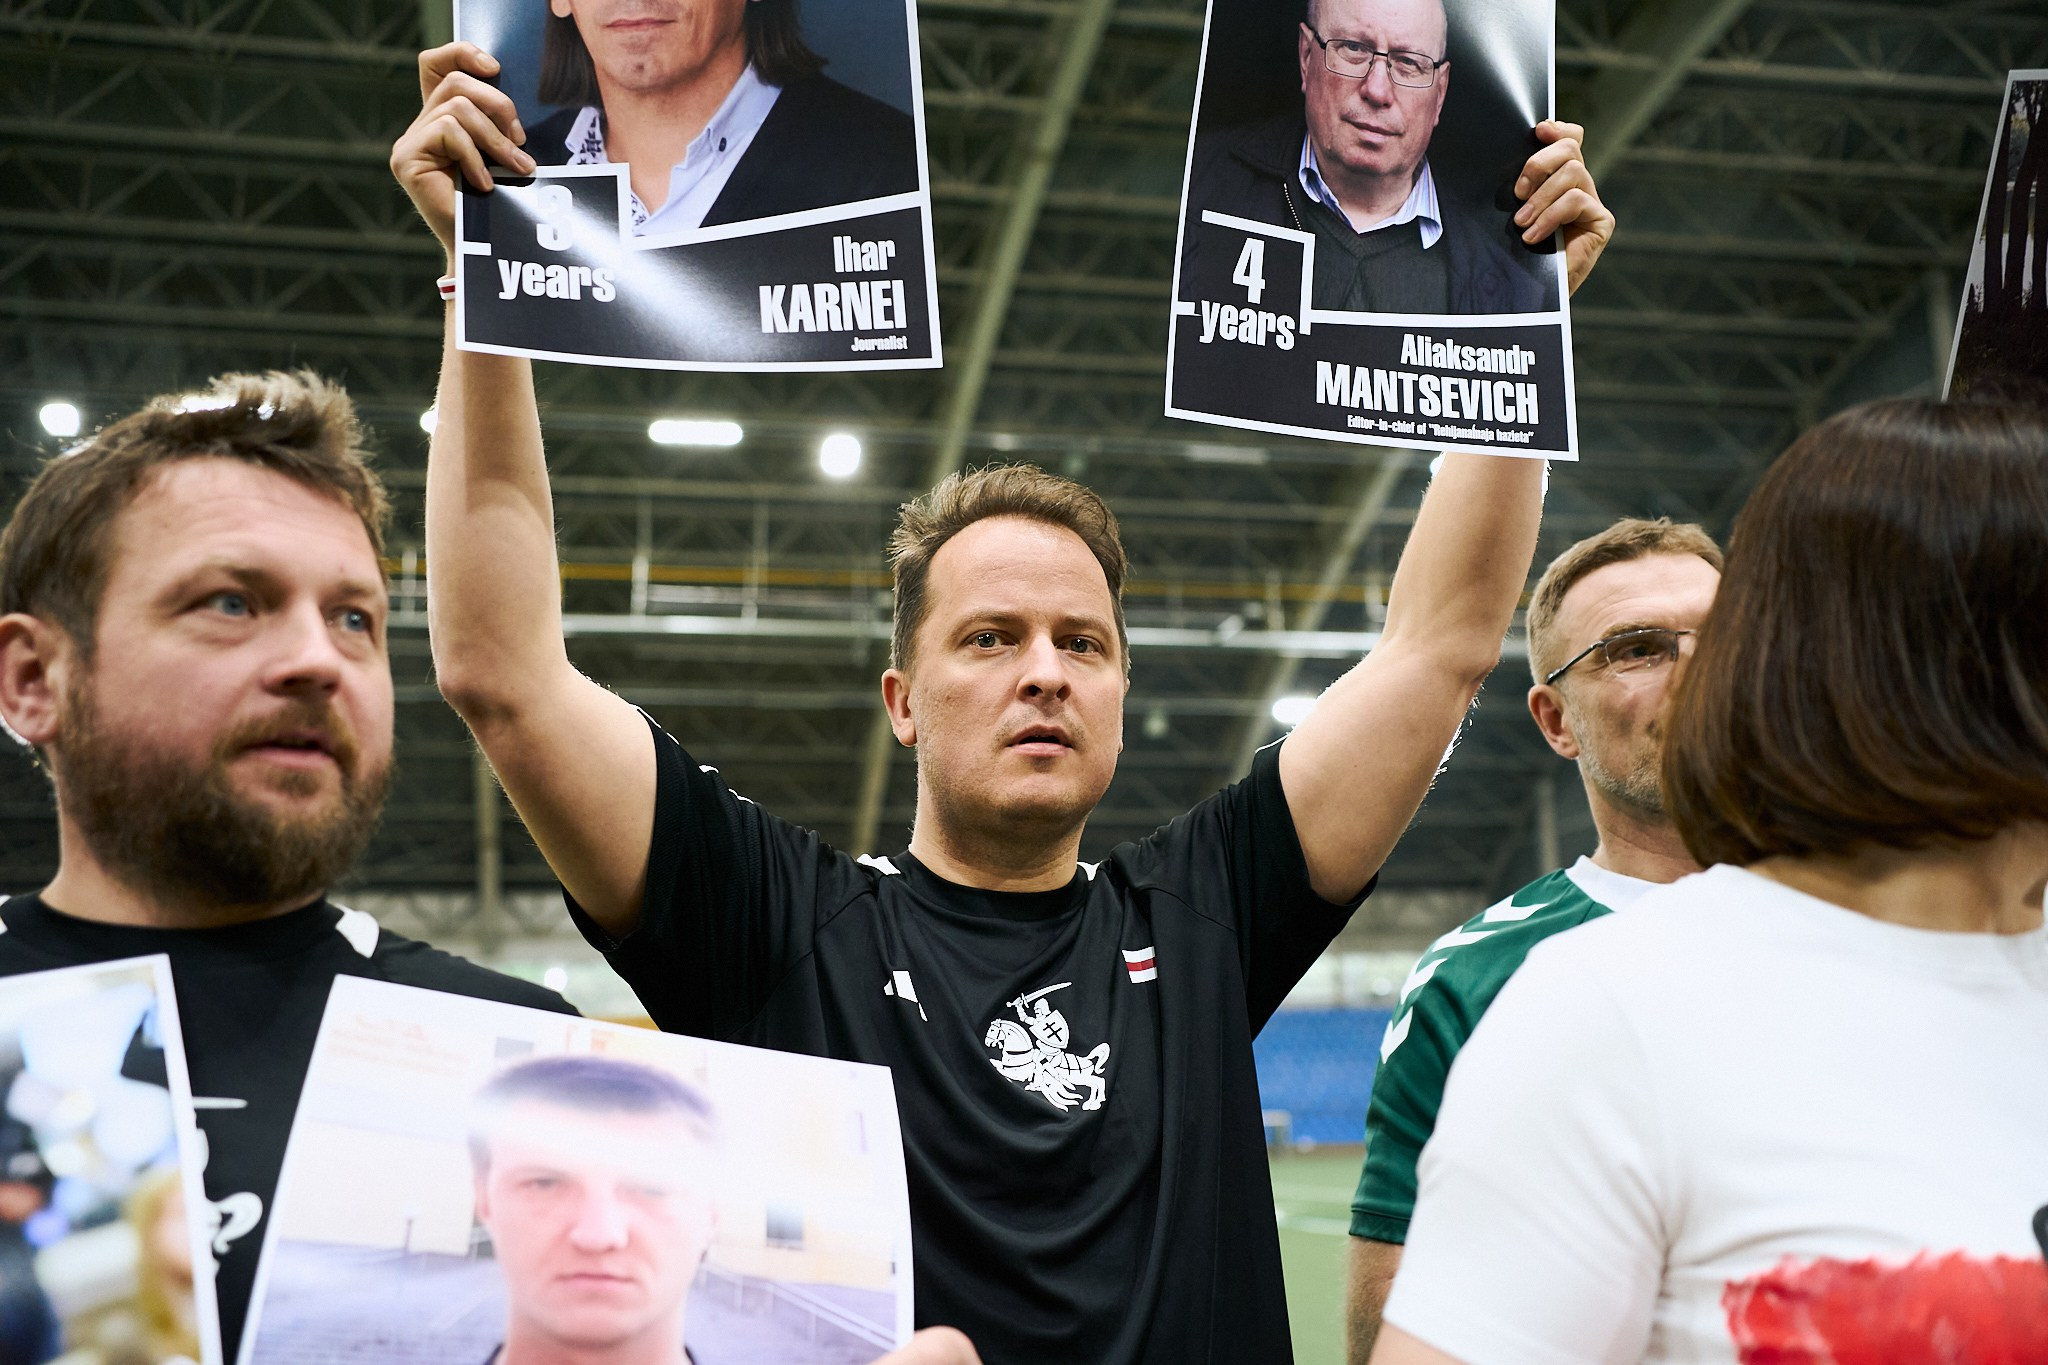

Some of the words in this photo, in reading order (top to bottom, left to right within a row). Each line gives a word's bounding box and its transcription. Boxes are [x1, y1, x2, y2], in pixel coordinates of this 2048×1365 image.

[536, 184, 574, 251] 3
[833, 235, 895, 273] Ihar
[1232, 237, 1266, 304] 4
[498, 258, 616, 303] years
[759, 279, 907, 334] KARNEI
[1199, 299, 1296, 351] years
[851, 335, 908, 352] Journalist
[1400, 333, 1536, 376] Aliaksandr
[1316, 360, 1539, 425] MANTSEVICH
[1347, 414, 1415, 434] Editor-in-chief
[1416, 424, 1427, 435] of
